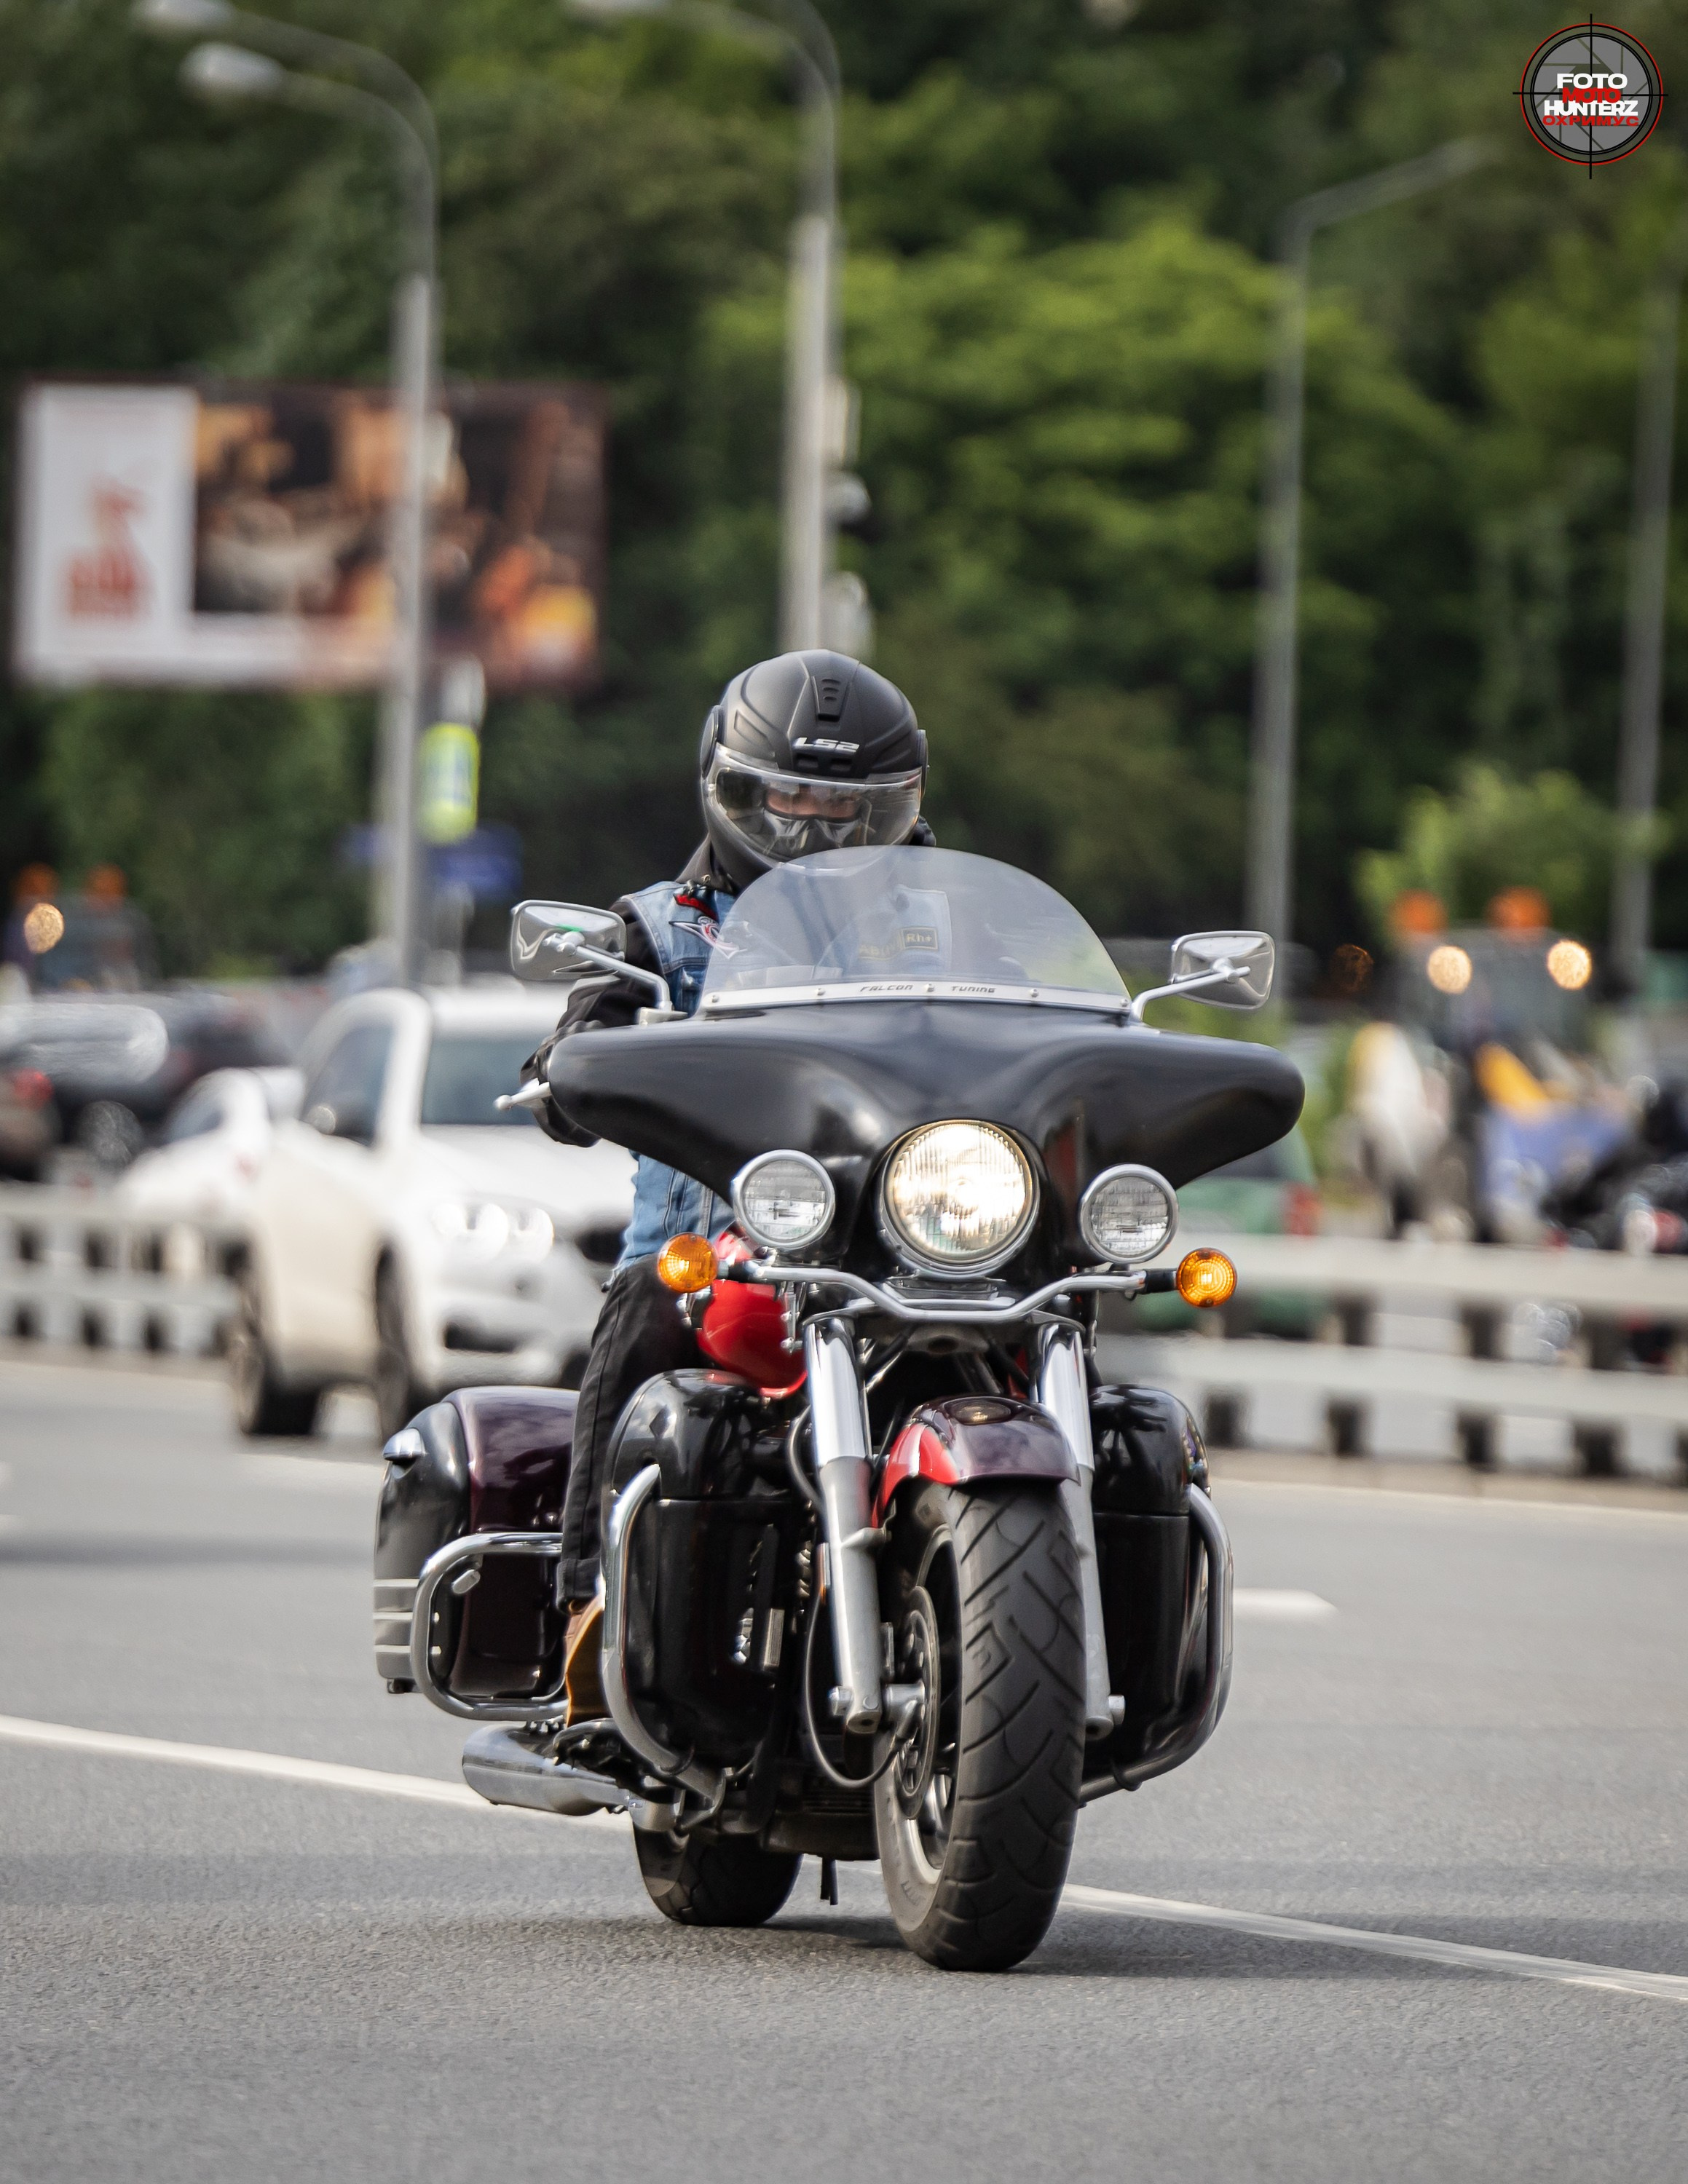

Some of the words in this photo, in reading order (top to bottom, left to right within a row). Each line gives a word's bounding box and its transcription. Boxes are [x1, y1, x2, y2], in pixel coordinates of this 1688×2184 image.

[792, 737, 860, 753] LS2
[859, 984, 914, 992] FALCON
[951, 985, 998, 994] TUNING
